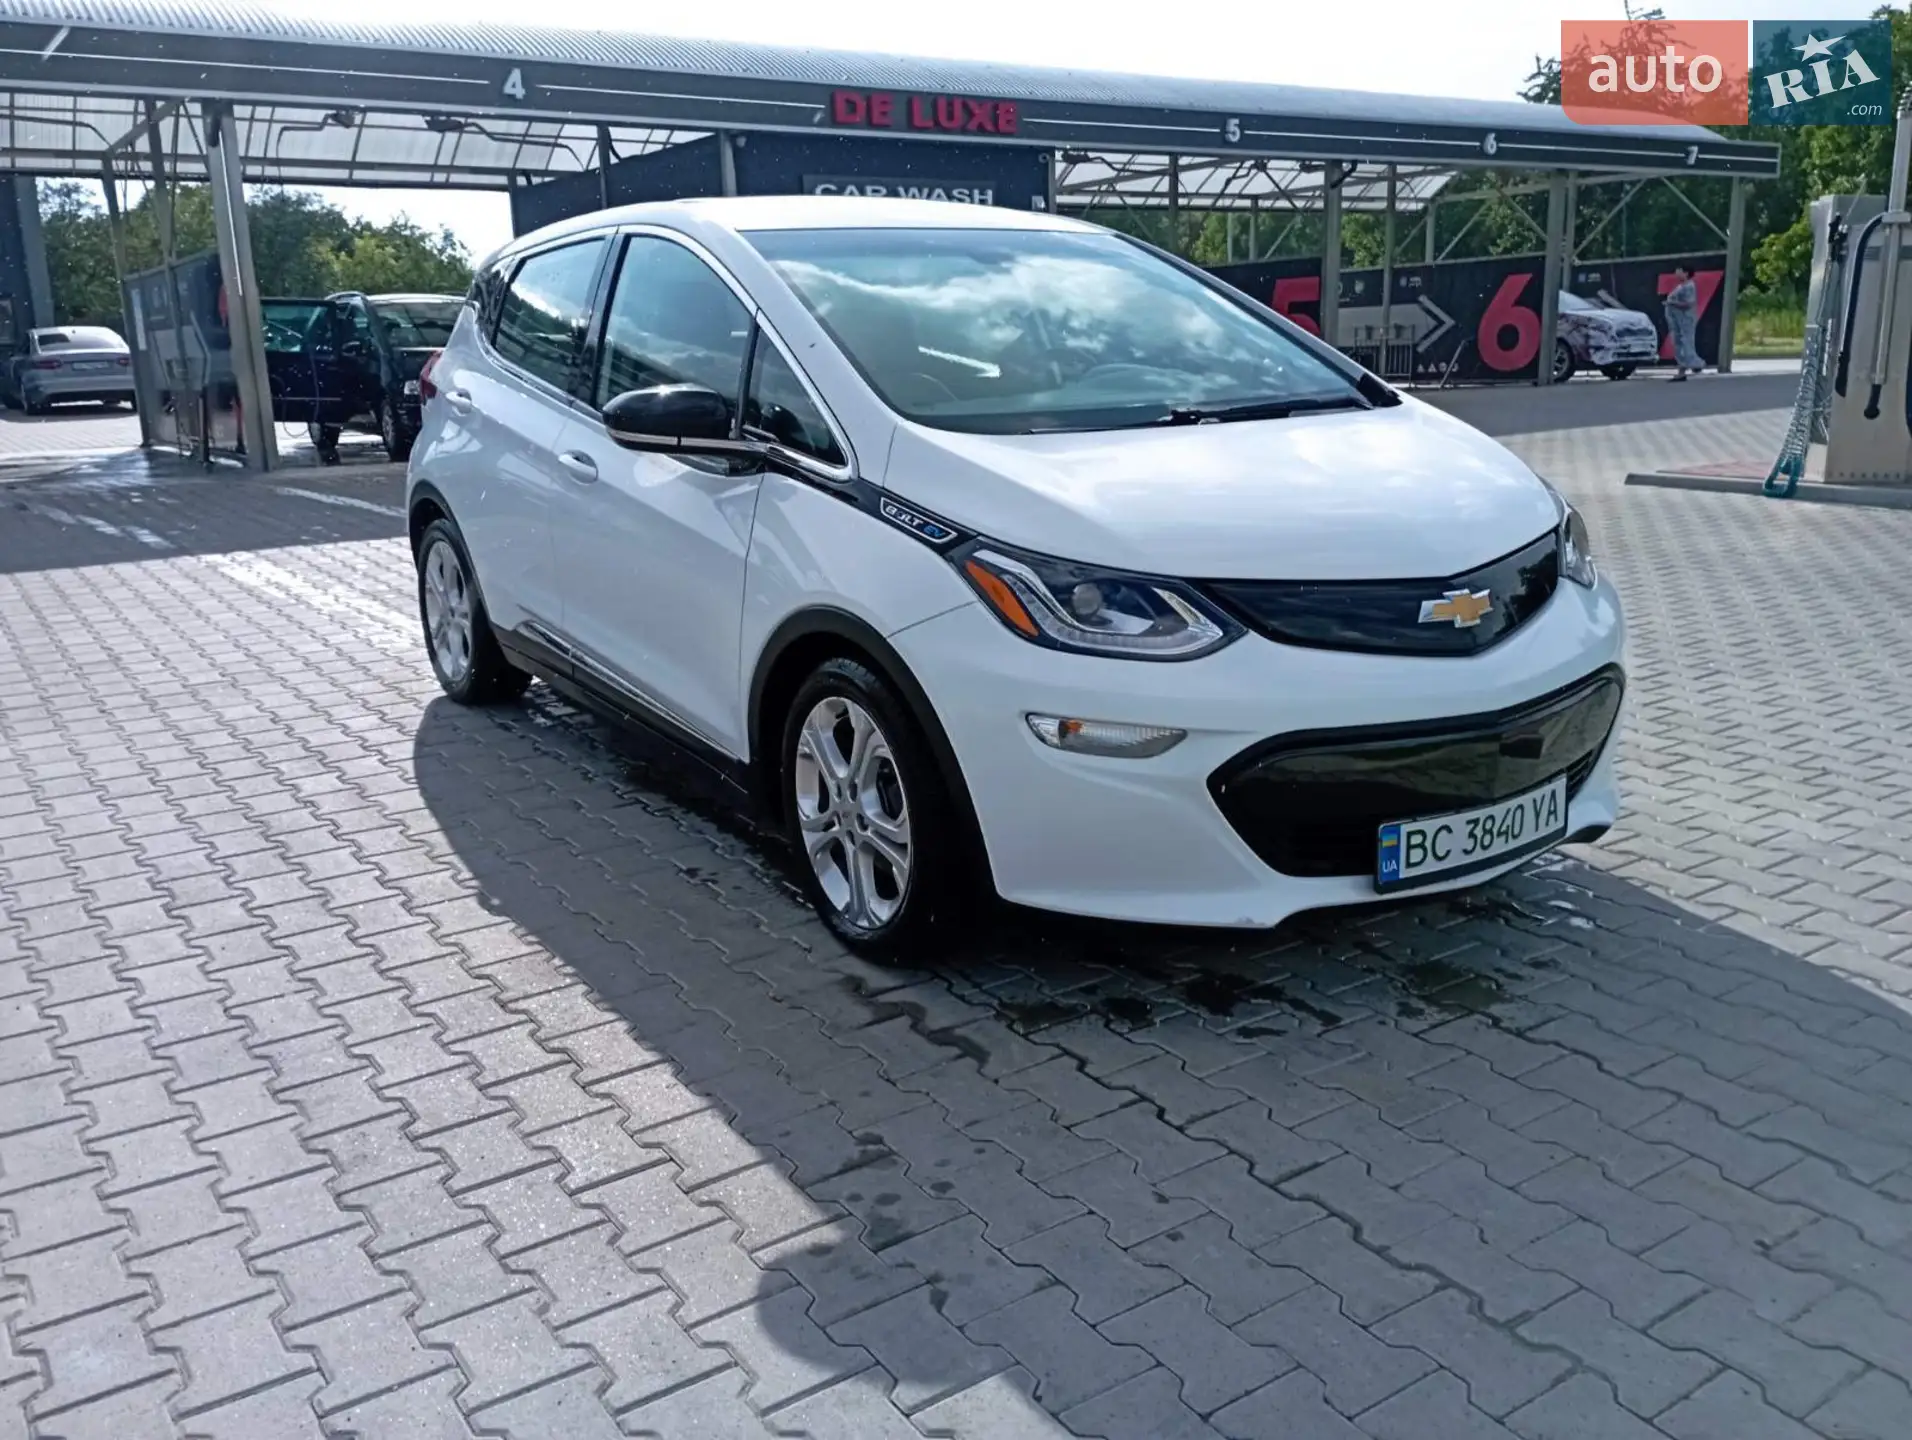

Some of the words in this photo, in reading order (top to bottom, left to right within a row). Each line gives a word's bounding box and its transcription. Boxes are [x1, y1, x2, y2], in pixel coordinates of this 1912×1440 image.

[503, 67, 526, 99] 4
[832, 90, 895, 128] DE
[909, 95, 1018, 136] LUXE
[1224, 118, 1241, 142] 5
[1483, 132, 1498, 155] 6
[1685, 145, 1699, 165] 7
[897, 186, 993, 206] WASH
[1477, 273, 1541, 372] 6
[1405, 824, 1454, 869] BC
[1462, 803, 1526, 856] 3840
[1532, 788, 1559, 833] YA
[1381, 862, 1399, 874] UA
